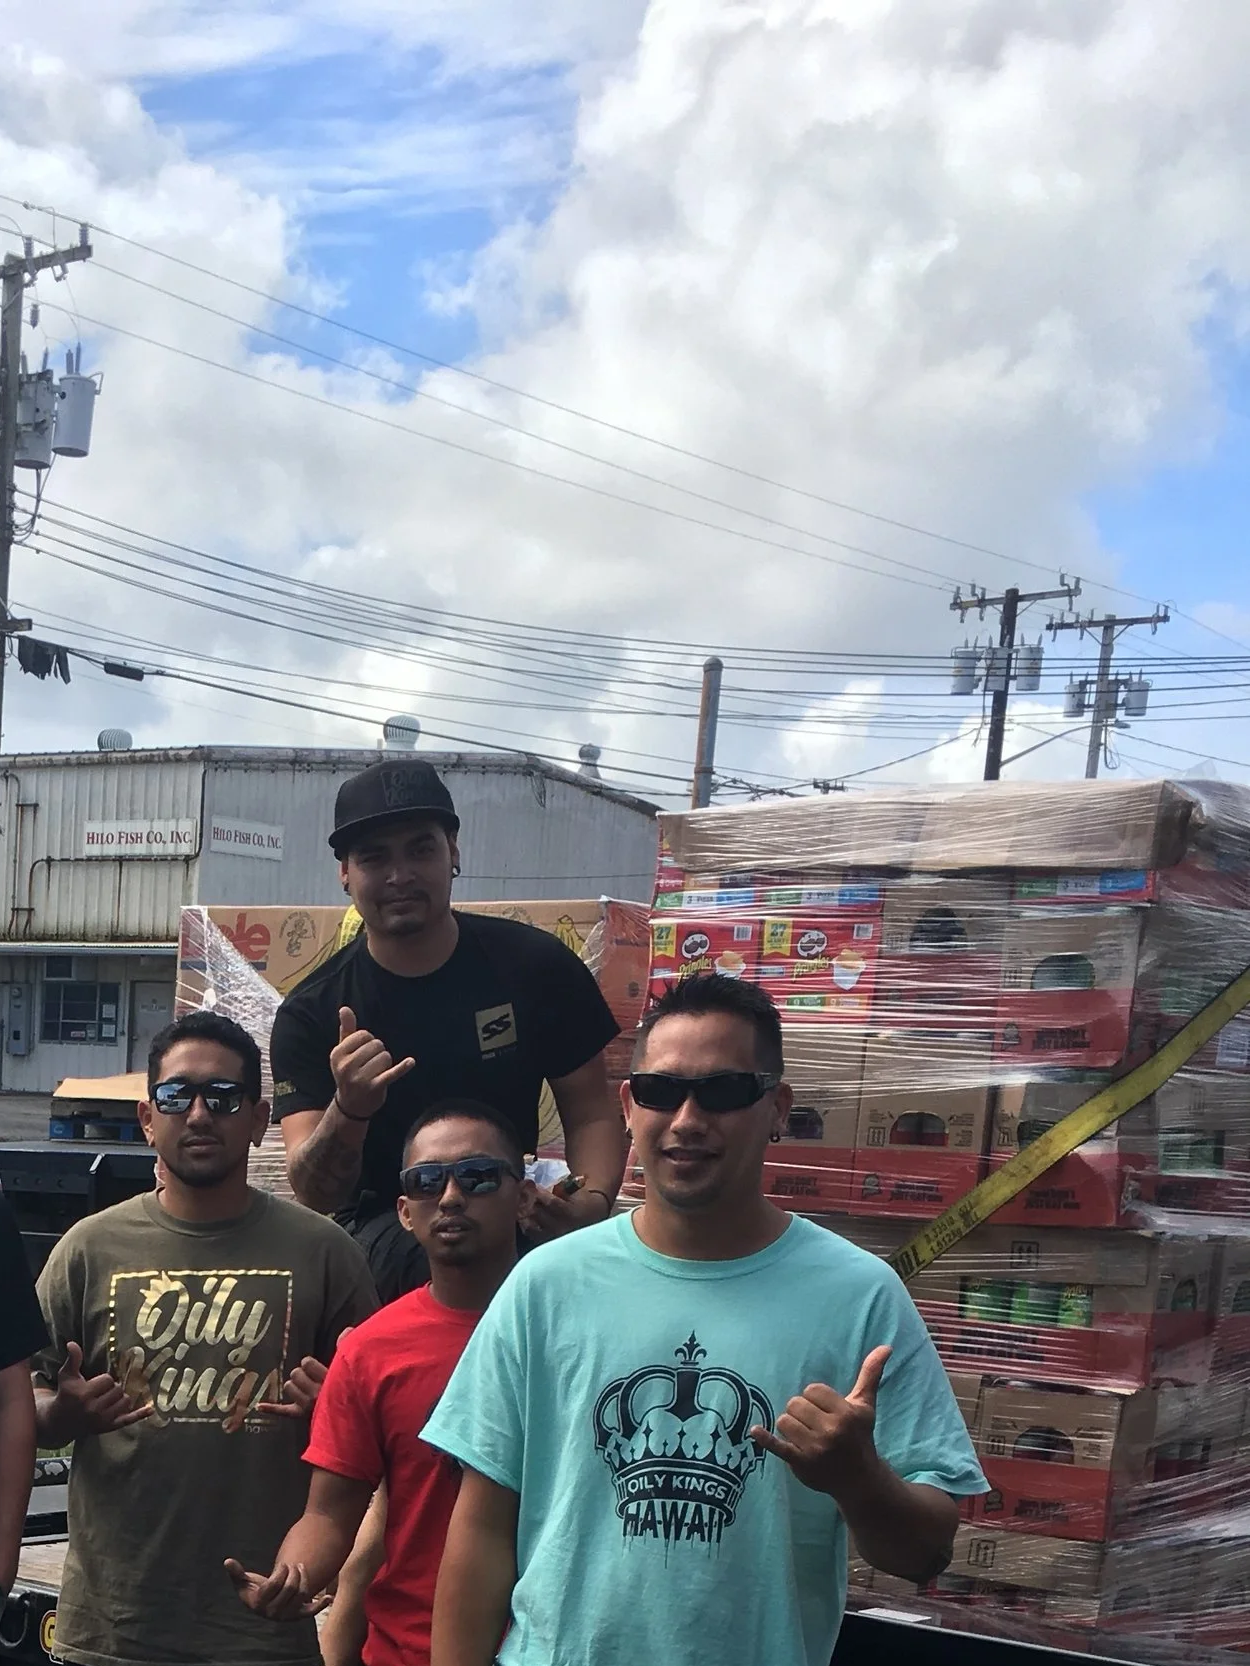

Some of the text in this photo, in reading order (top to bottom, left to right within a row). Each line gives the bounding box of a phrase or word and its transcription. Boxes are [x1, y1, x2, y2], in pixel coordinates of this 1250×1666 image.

[86, 831, 115, 845] HILO
[117, 831, 143, 845] FISH
[169, 830, 193, 844] INC.
[212, 826, 232, 842] HILO
[233, 829, 251, 845] FISH
[266, 834, 282, 849] INC.
[181, 911, 271, 961] Dle
[655, 926, 672, 940] 27
[770, 922, 786, 937] 27
[678, 955, 713, 984] Pringles
[793, 955, 831, 983] Pringles
[136, 1273, 274, 1366] Oily
[627, 1474, 728, 1500] OILY KINGS
[622, 1500, 725, 1546] HAWAII
